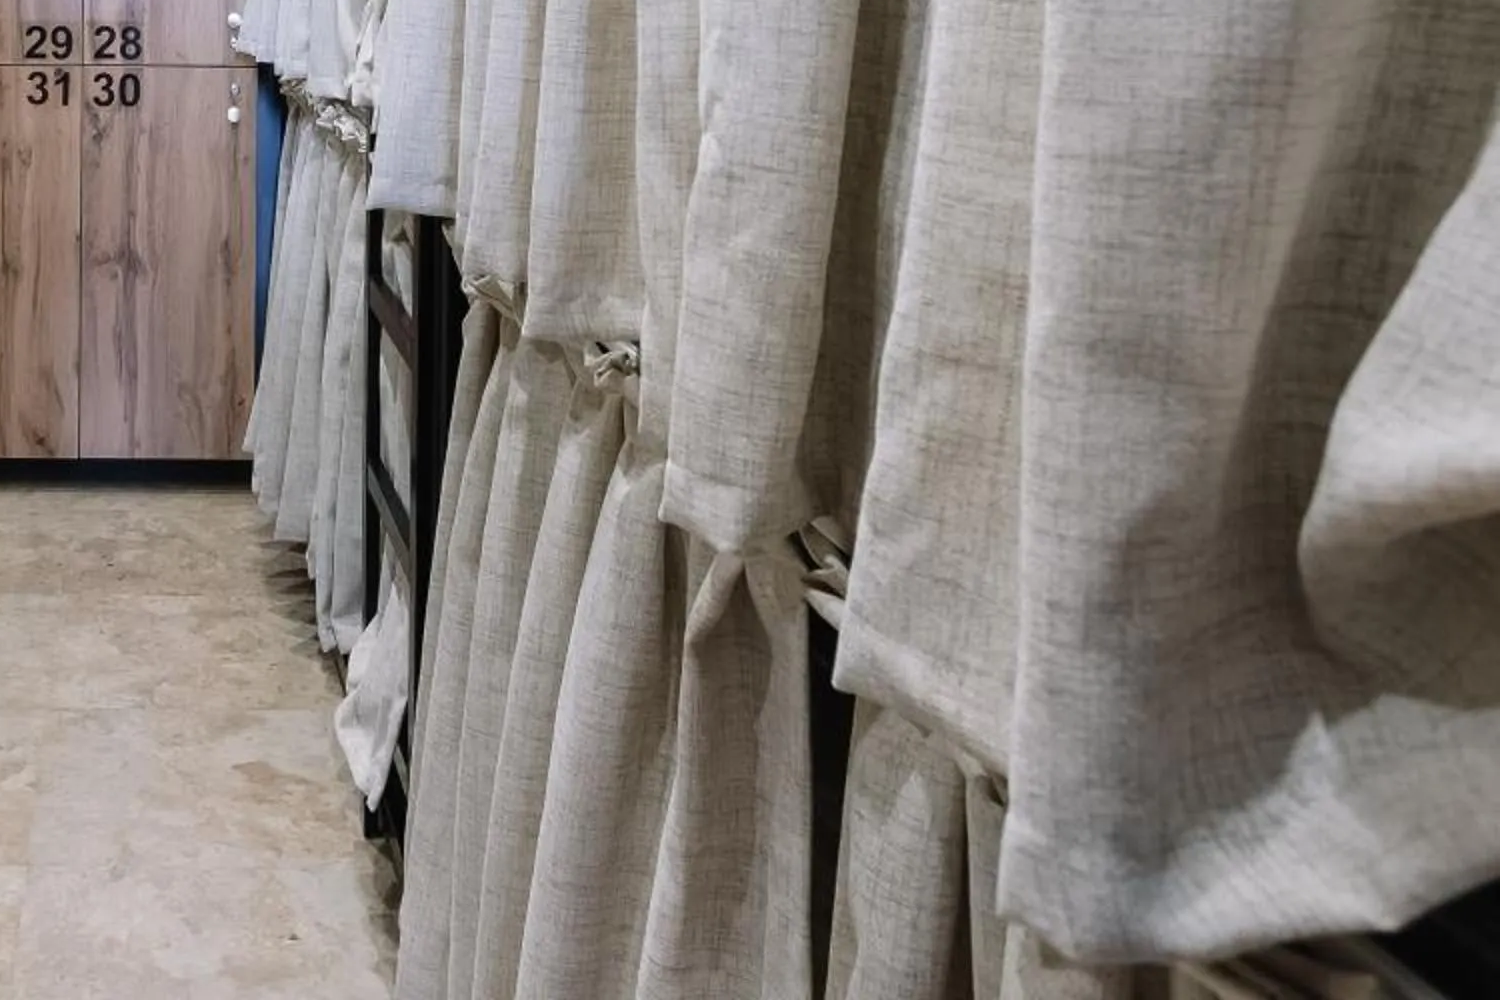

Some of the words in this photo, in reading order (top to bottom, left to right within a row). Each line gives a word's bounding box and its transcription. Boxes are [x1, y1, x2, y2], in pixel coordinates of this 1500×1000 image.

[24, 25, 73, 60] 29
[93, 25, 142, 61] 28
[27, 71, 71, 106] 31
[93, 72, 141, 107] 30
